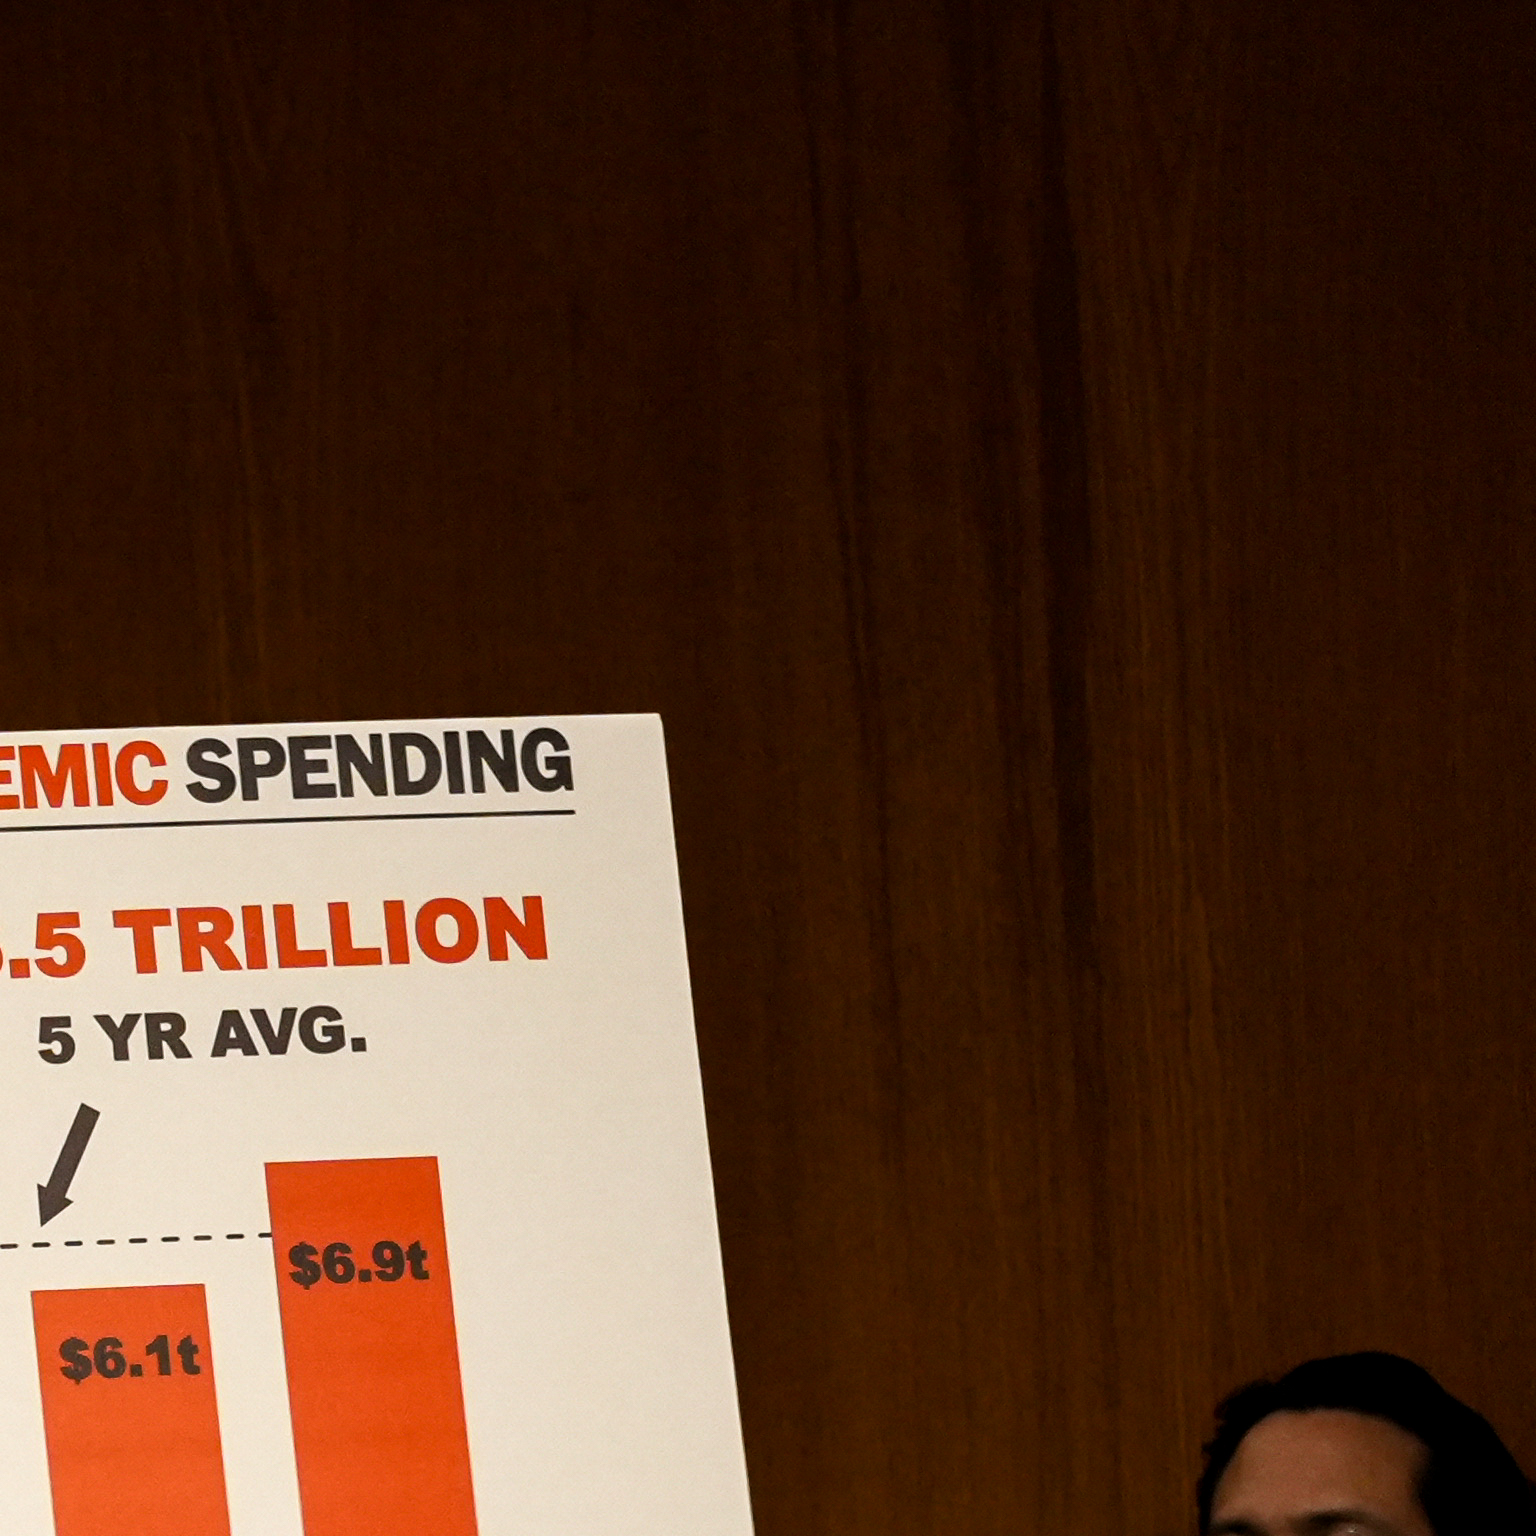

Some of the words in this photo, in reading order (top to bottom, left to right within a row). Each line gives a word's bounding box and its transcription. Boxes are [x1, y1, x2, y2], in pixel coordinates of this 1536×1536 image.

[184, 727, 576, 804] SPENDING
[113, 897, 549, 975] TRILLION
[40, 1017, 76, 1065] 5
[95, 1014, 193, 1062] YR
[212, 1007, 367, 1058] AVG.
[290, 1242, 430, 1291] $6.9t
[60, 1336, 202, 1386] $6.1t
